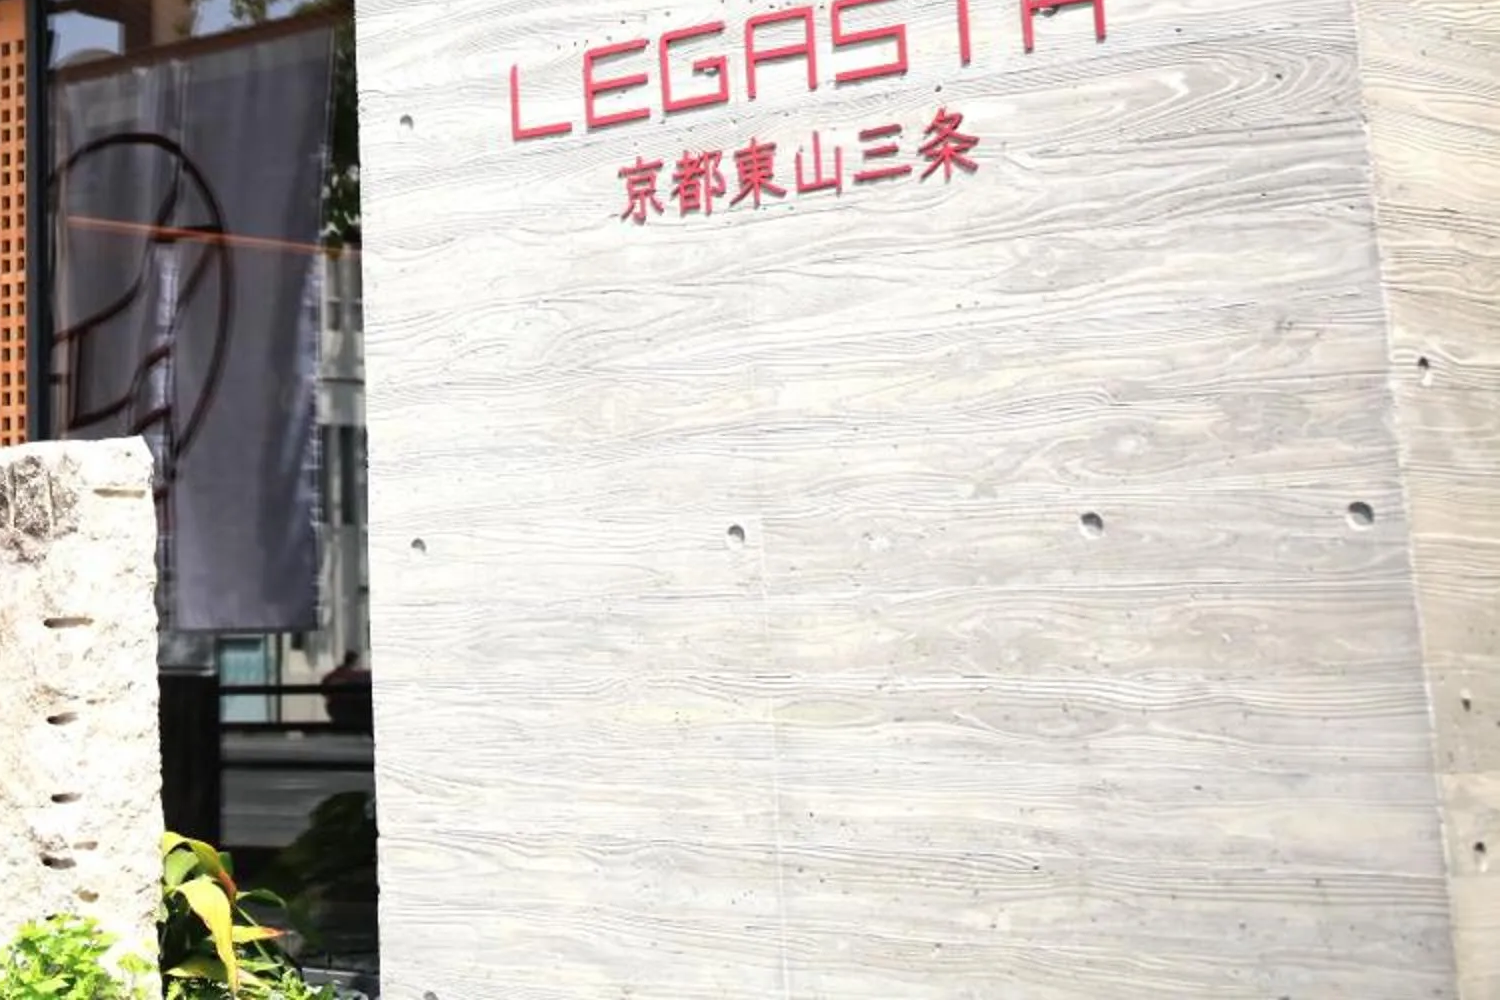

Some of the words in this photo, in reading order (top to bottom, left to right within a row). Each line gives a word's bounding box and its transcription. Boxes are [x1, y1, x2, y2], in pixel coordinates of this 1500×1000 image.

[617, 107, 980, 222] 京都東山三条
